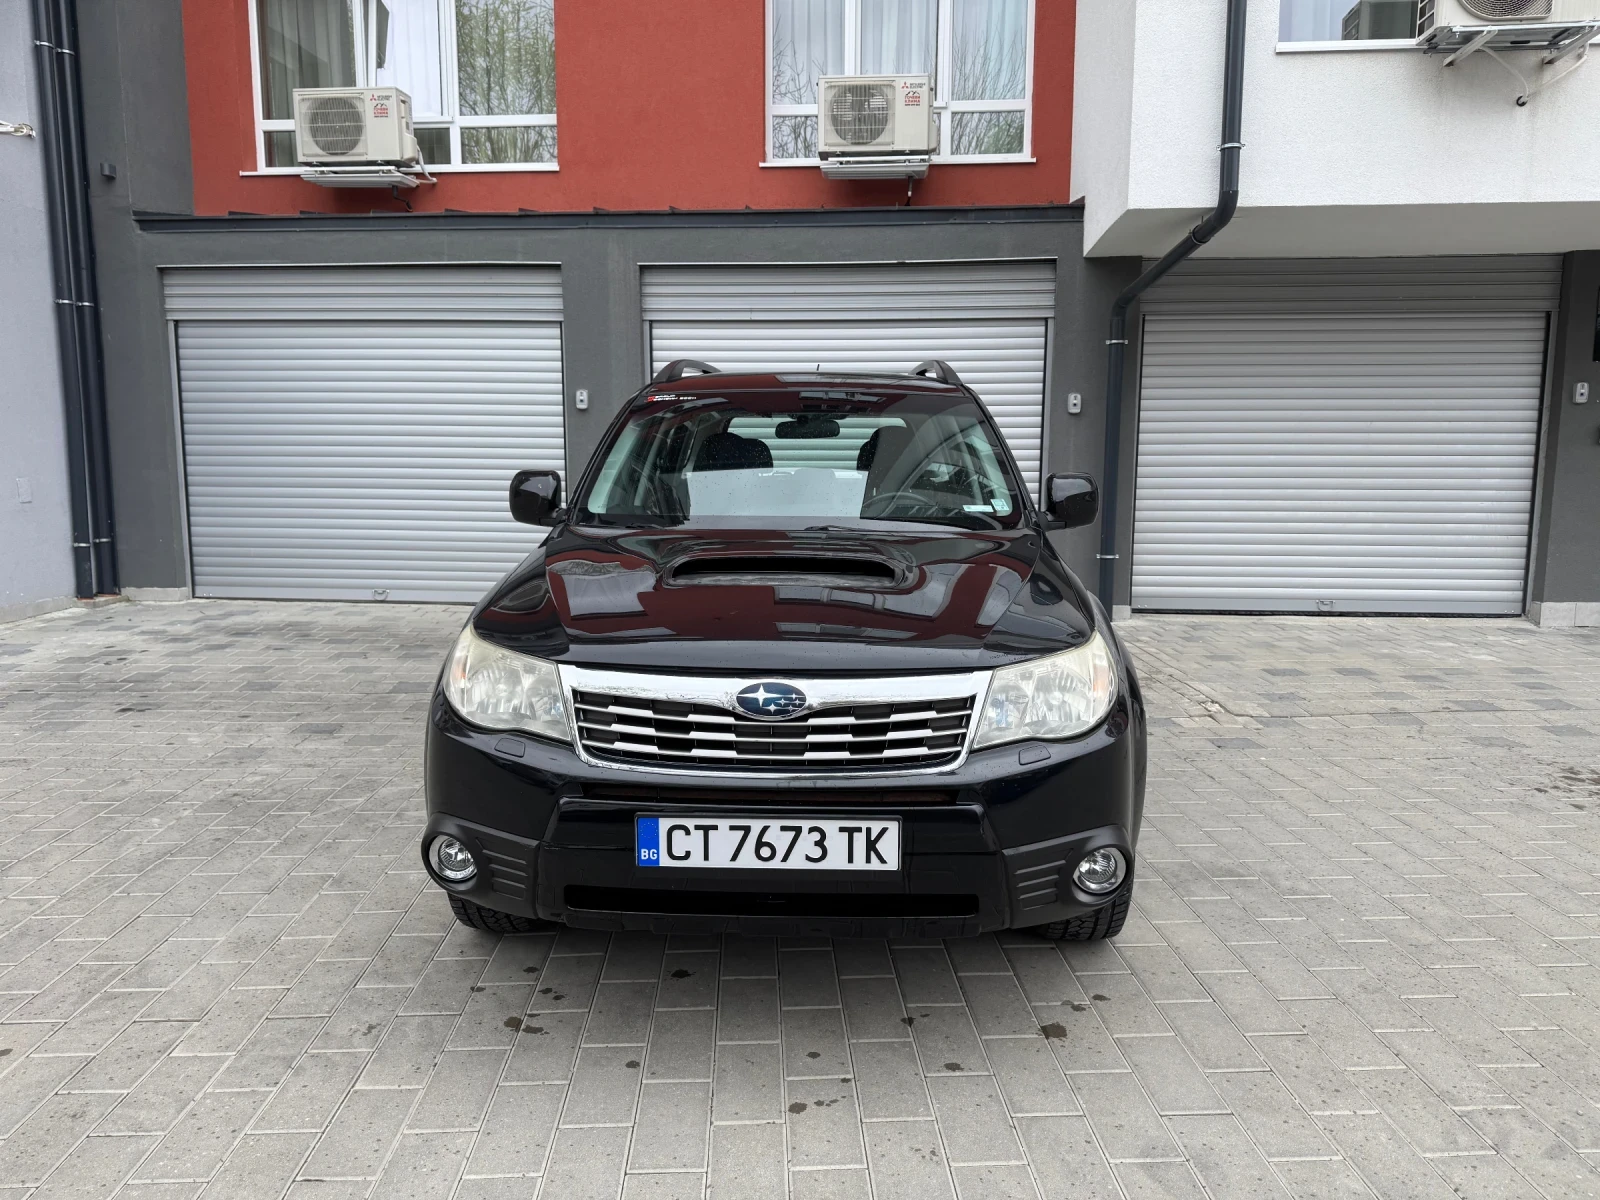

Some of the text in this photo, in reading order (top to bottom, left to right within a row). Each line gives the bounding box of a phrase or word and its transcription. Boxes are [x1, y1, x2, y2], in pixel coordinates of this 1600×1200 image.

[641, 848, 658, 860] BG
[666, 824, 889, 864] CT 7673 TK
